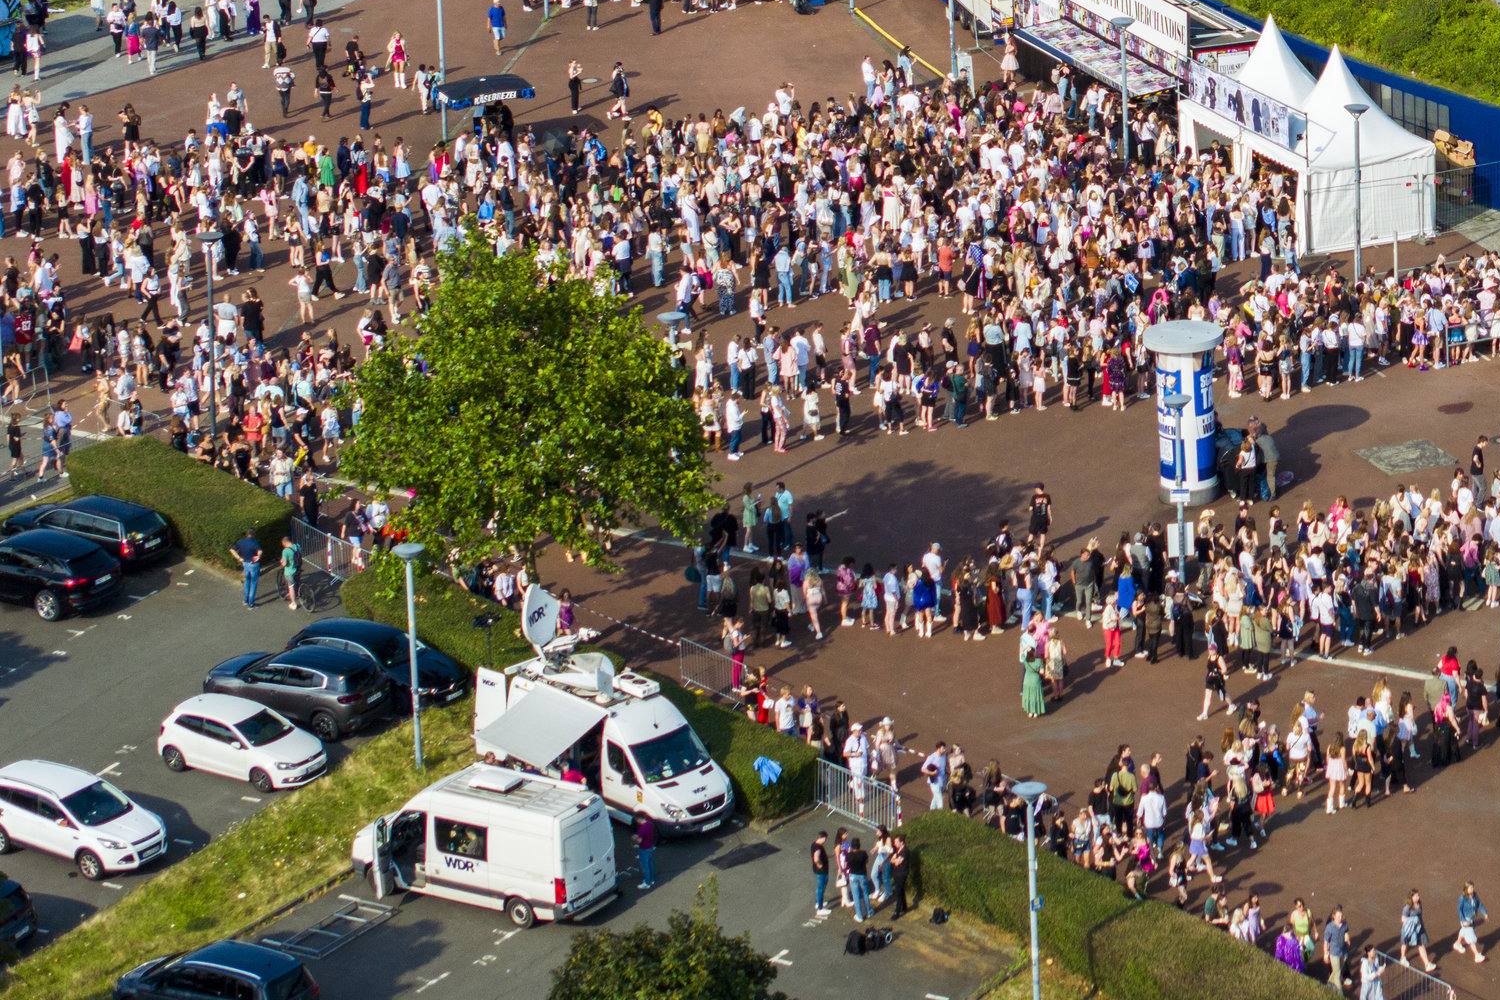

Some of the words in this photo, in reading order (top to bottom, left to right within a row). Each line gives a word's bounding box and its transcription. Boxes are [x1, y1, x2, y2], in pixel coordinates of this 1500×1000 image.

[1134, 0, 1186, 46] MERCHANDISE
[528, 606, 546, 627] WDR
[445, 856, 475, 873] WDR
